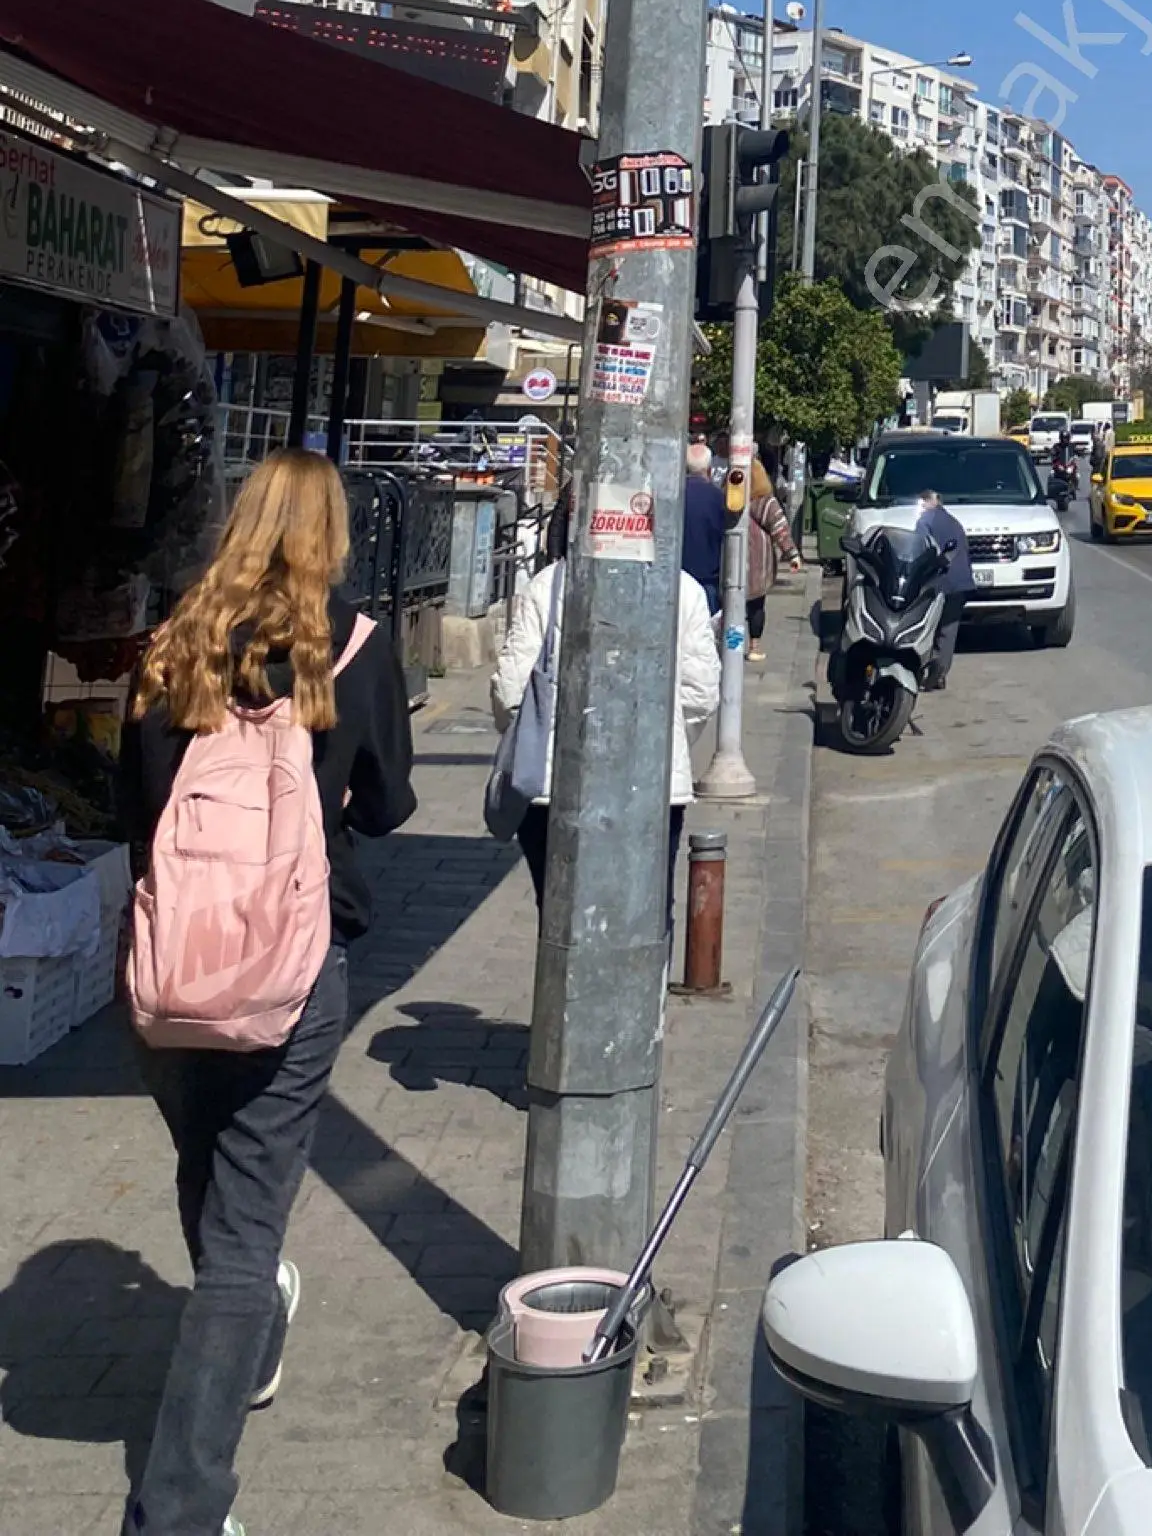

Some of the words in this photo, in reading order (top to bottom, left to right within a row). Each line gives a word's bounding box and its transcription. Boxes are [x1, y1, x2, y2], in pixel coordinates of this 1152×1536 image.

[27, 182, 129, 274] BAHARAT
[26, 249, 112, 296] PERAKENDE
[590, 515, 654, 532] ZORUNDA
